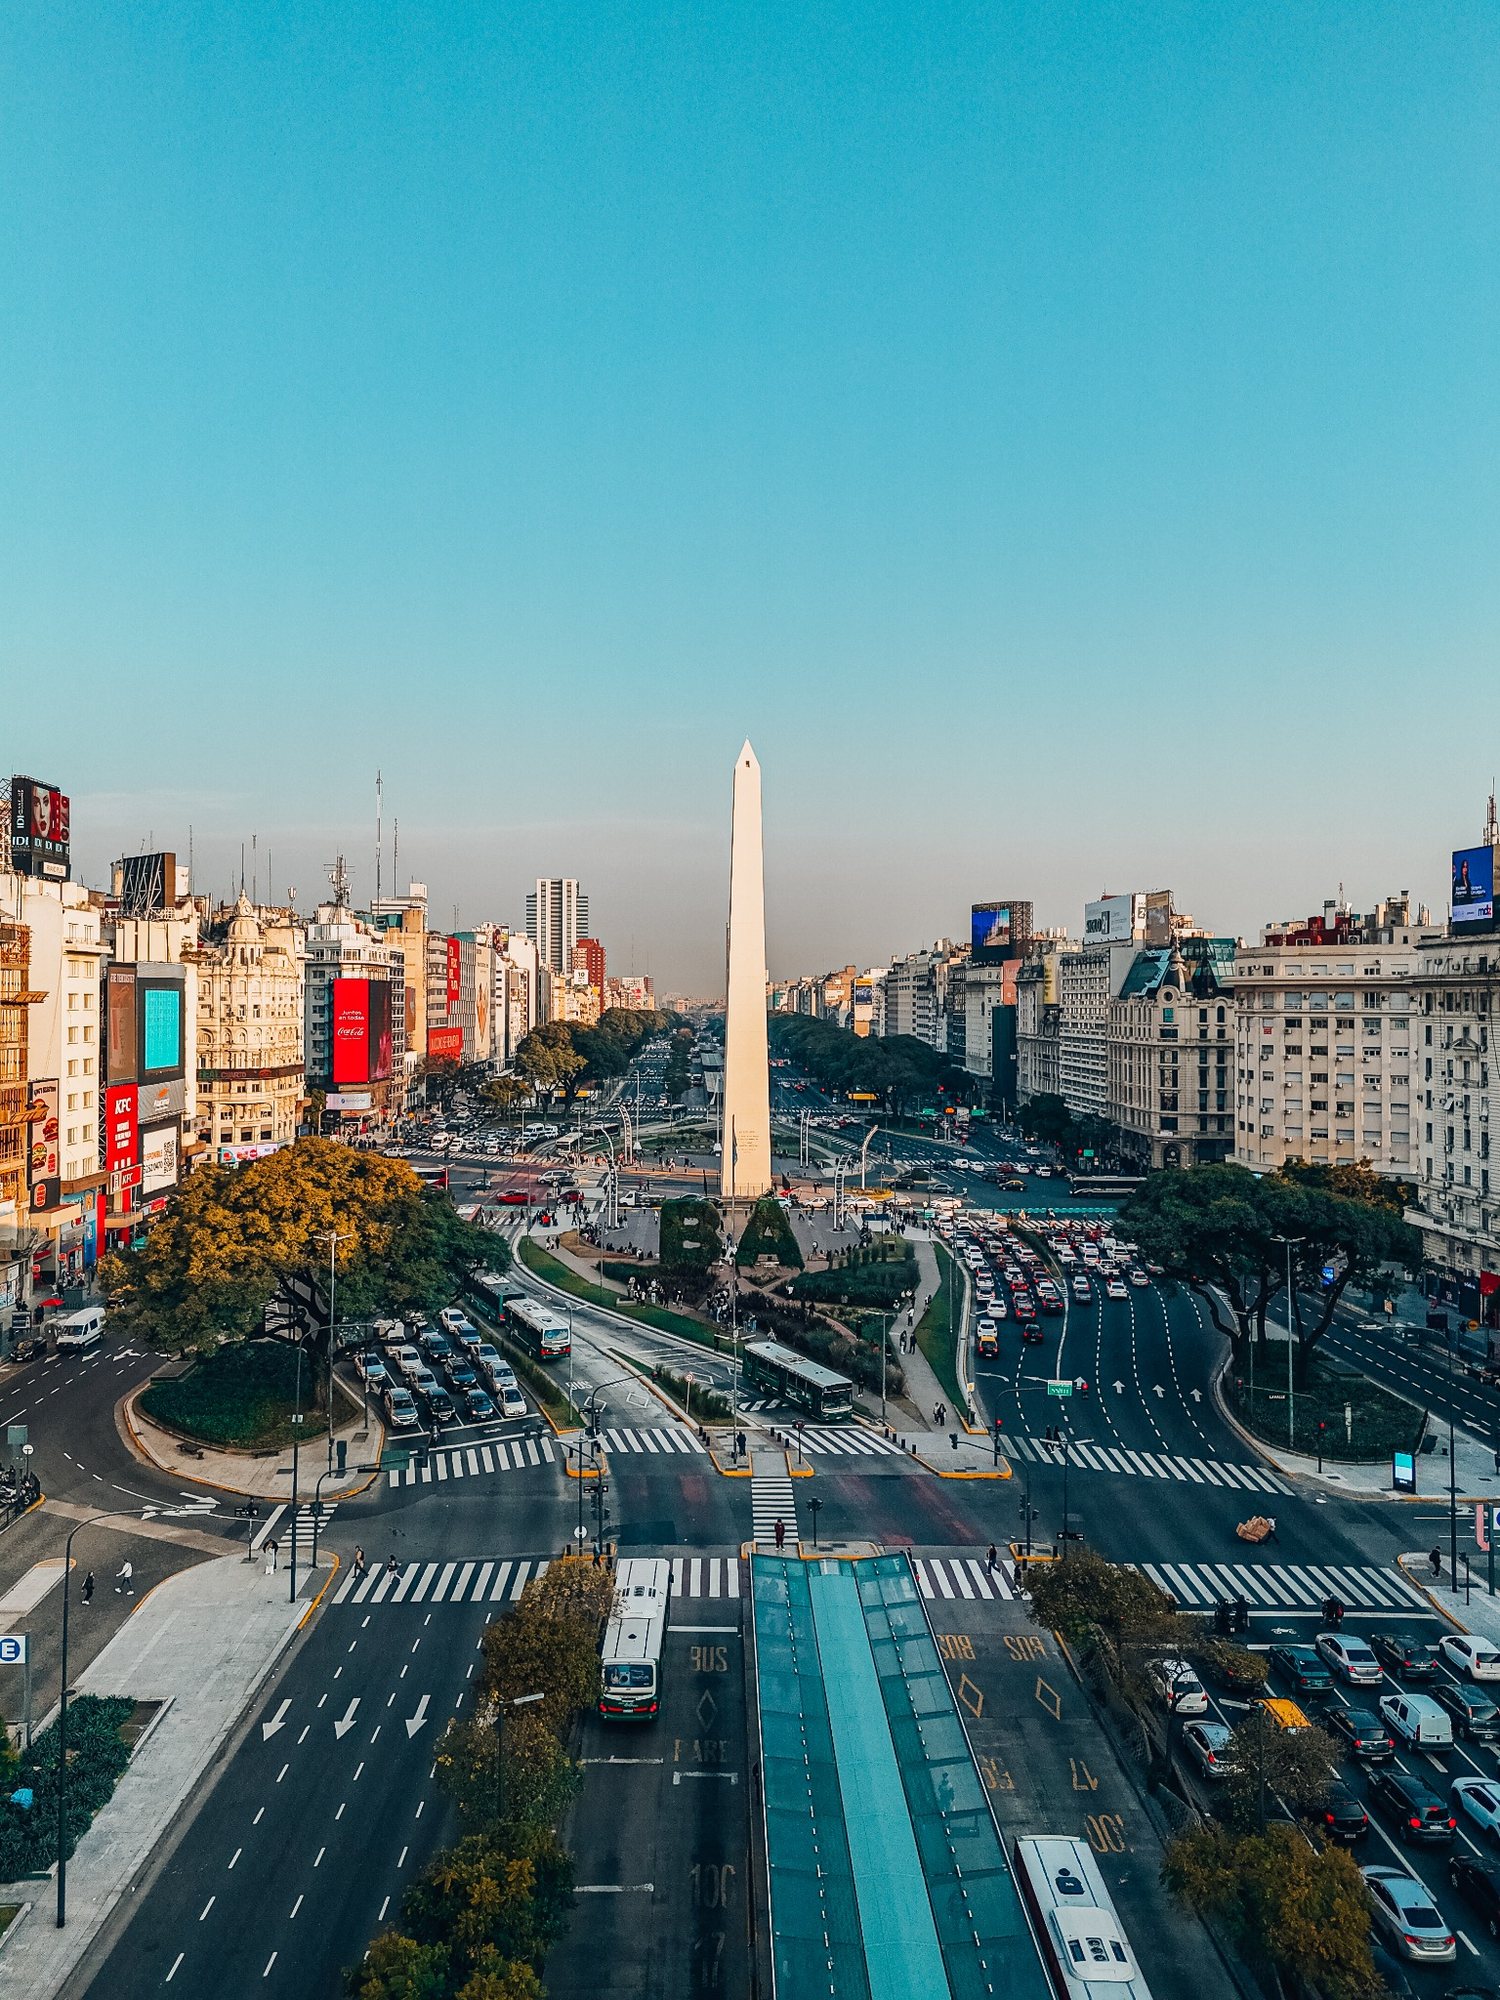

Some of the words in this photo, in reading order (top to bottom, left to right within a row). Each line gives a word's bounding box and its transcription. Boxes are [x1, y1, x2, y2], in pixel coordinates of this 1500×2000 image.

[17, 815, 25, 829] IDI
[12, 836, 29, 846] IDI
[115, 1098, 132, 1115] KFC
[122, 1172, 134, 1185] KFC
[1, 1642, 16, 1658] E
[690, 1646, 728, 1673] BUS
[1069, 1757, 1100, 1791] 17
